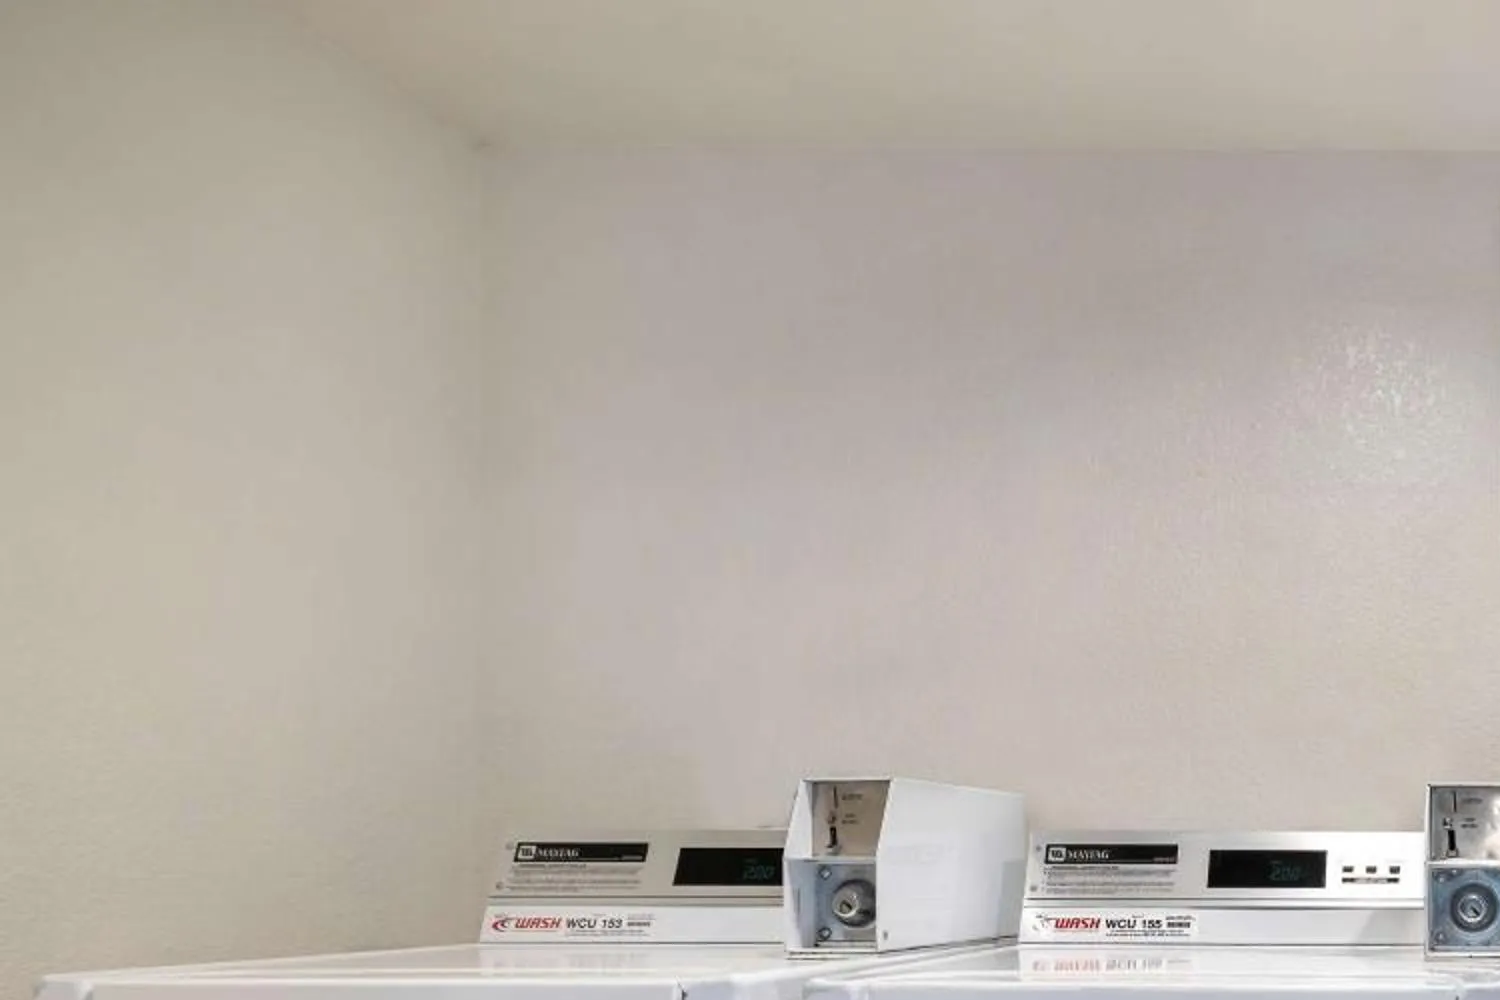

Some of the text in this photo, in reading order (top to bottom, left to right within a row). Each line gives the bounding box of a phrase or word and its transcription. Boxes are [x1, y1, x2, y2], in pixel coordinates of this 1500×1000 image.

[514, 917, 563, 928] WASH
[566, 918, 597, 929] WCU
[601, 918, 623, 929] 153
[1053, 917, 1101, 929] WASH
[1105, 919, 1137, 929] WCU
